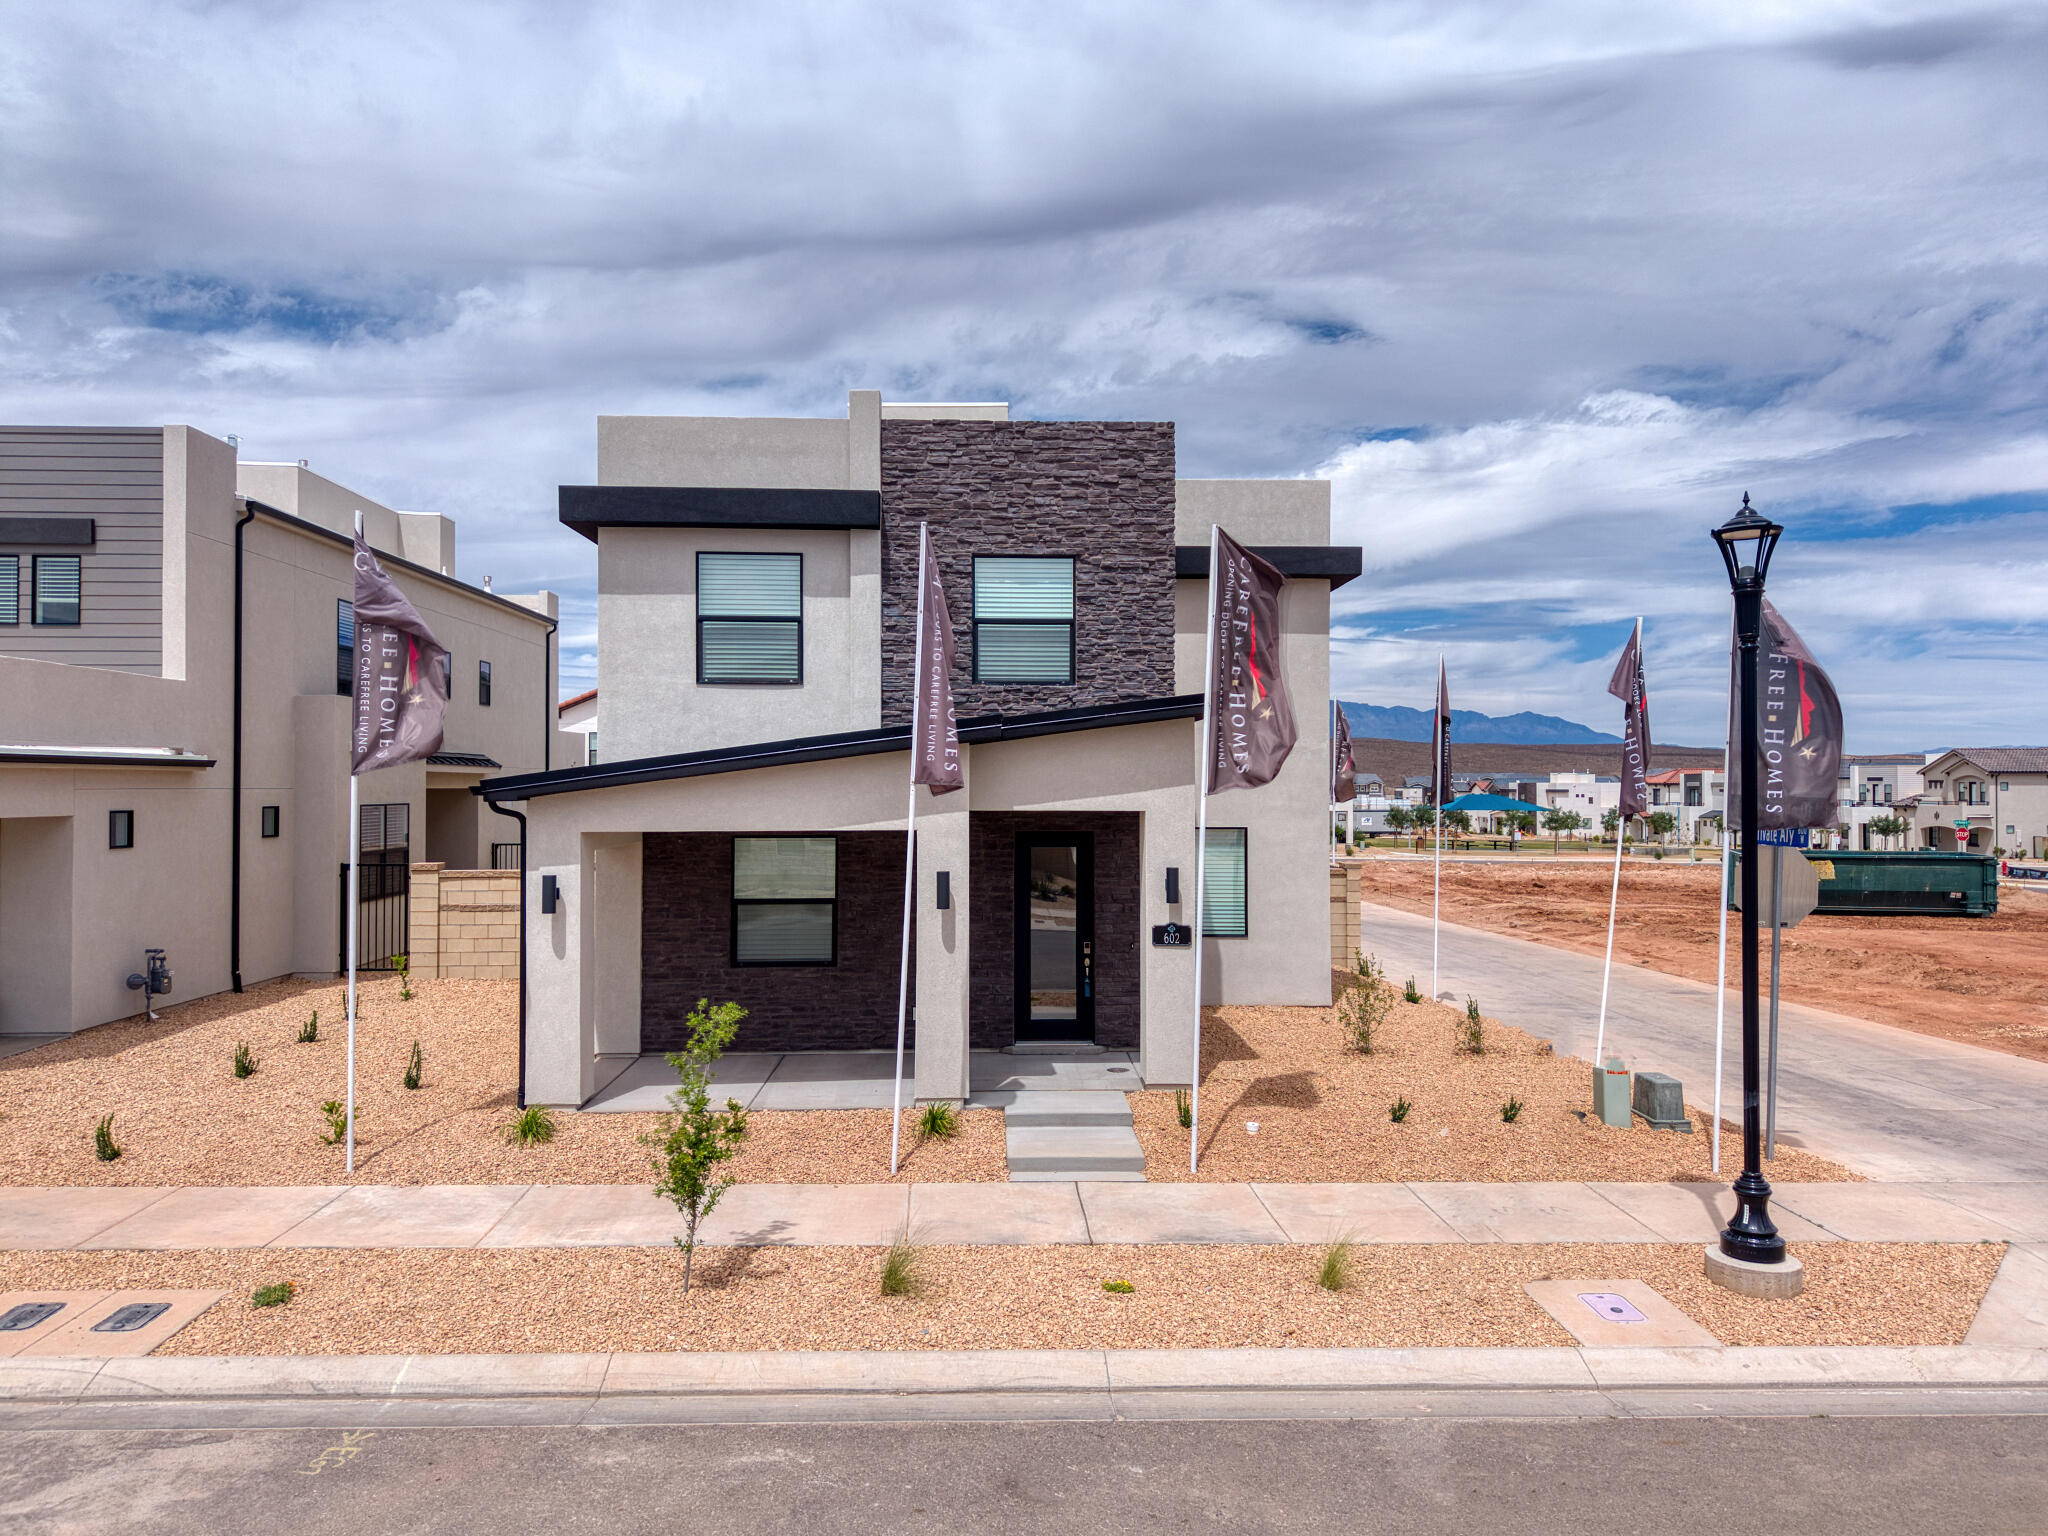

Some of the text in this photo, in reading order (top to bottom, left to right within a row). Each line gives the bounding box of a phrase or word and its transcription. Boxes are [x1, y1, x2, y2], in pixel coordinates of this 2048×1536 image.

[1223, 559, 1235, 607] OPENING
[362, 638, 371, 652] TO
[1220, 612, 1233, 649] DOORS
[933, 646, 943, 660] TO
[360, 657, 371, 711] CAREFREE
[930, 666, 942, 720] CAREFREE
[358, 716, 369, 753] LIVING
[926, 724, 937, 762] LIVING
[1217, 731, 1227, 768] LIVING
[1228, 692, 1250, 774] HOMES
[1765, 728, 1785, 814] HOMES
[1780, 828, 1794, 846] Aly
[1163, 932, 1180, 944] 602
